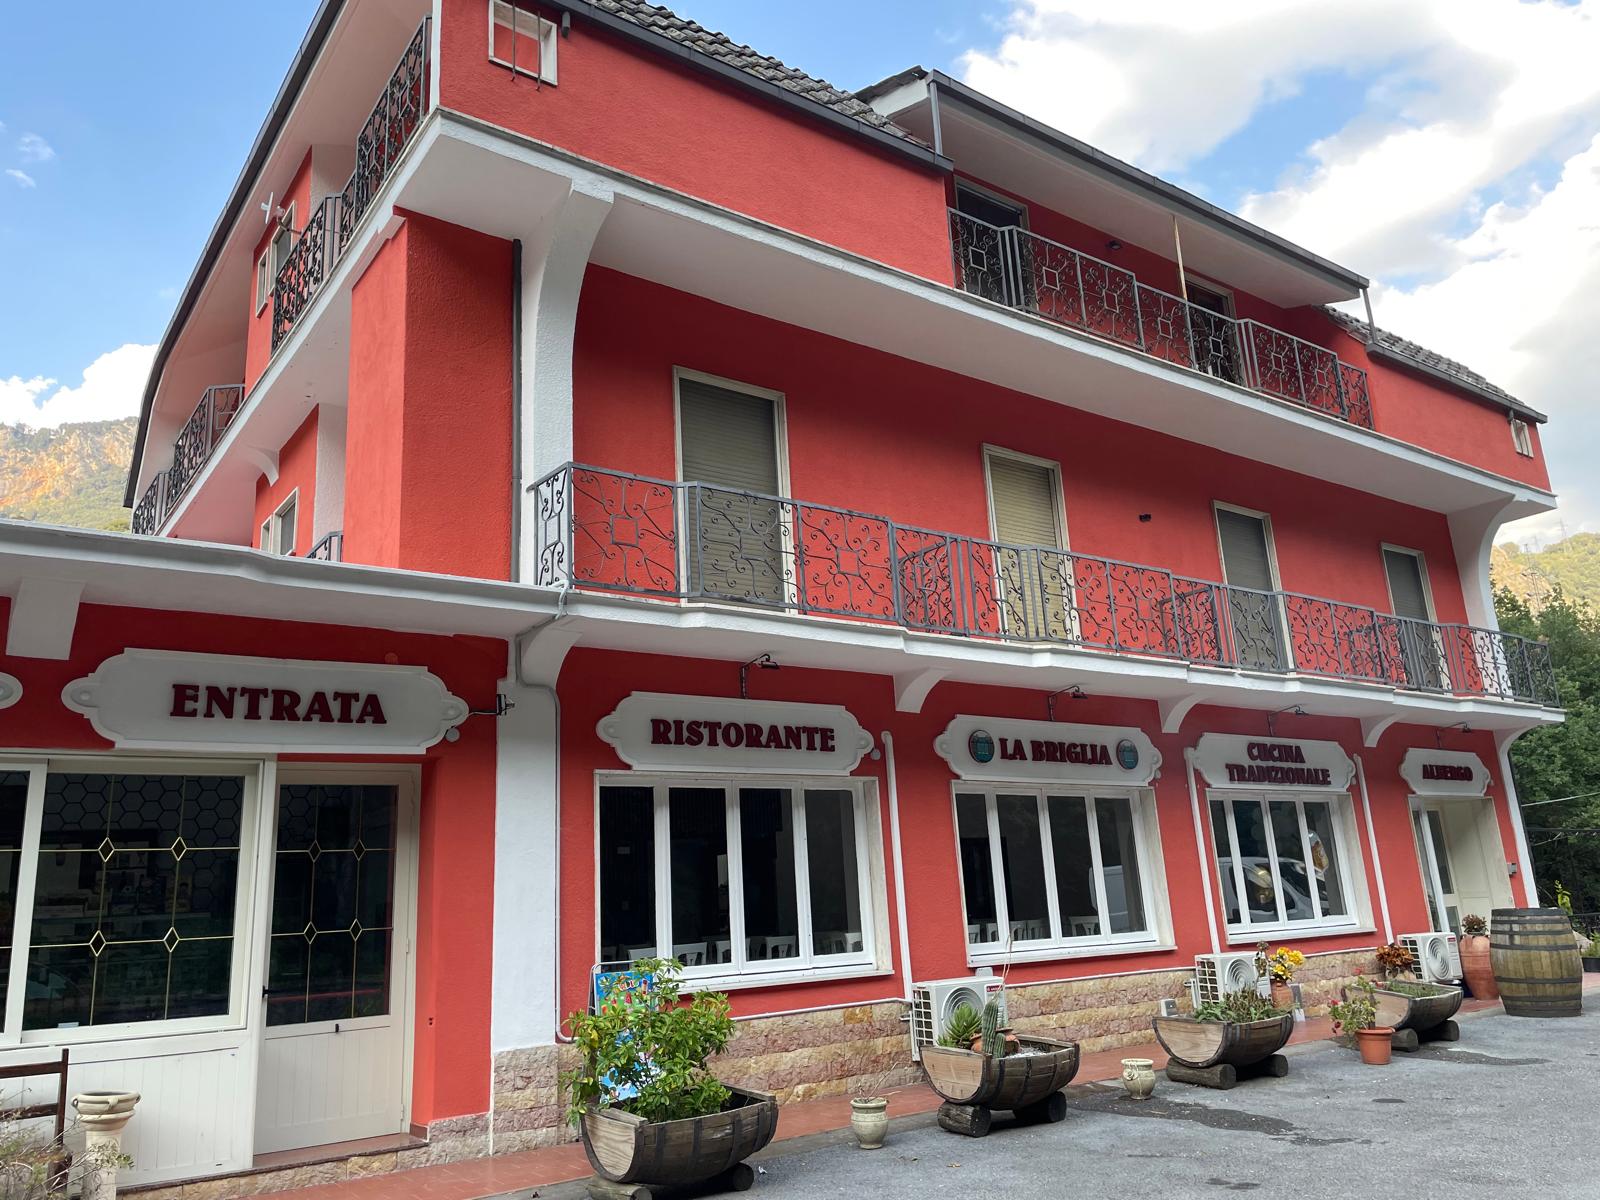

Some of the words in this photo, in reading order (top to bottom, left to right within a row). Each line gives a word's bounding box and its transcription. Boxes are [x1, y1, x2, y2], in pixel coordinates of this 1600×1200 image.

[170, 684, 387, 724] ENTRATA
[650, 719, 836, 752] RISTORANTE
[999, 738, 1028, 761] LA
[1030, 740, 1113, 765] BRIGLIA
[1247, 742, 1306, 763] CUCINA
[1225, 763, 1332, 785] TRADIZIONALE
